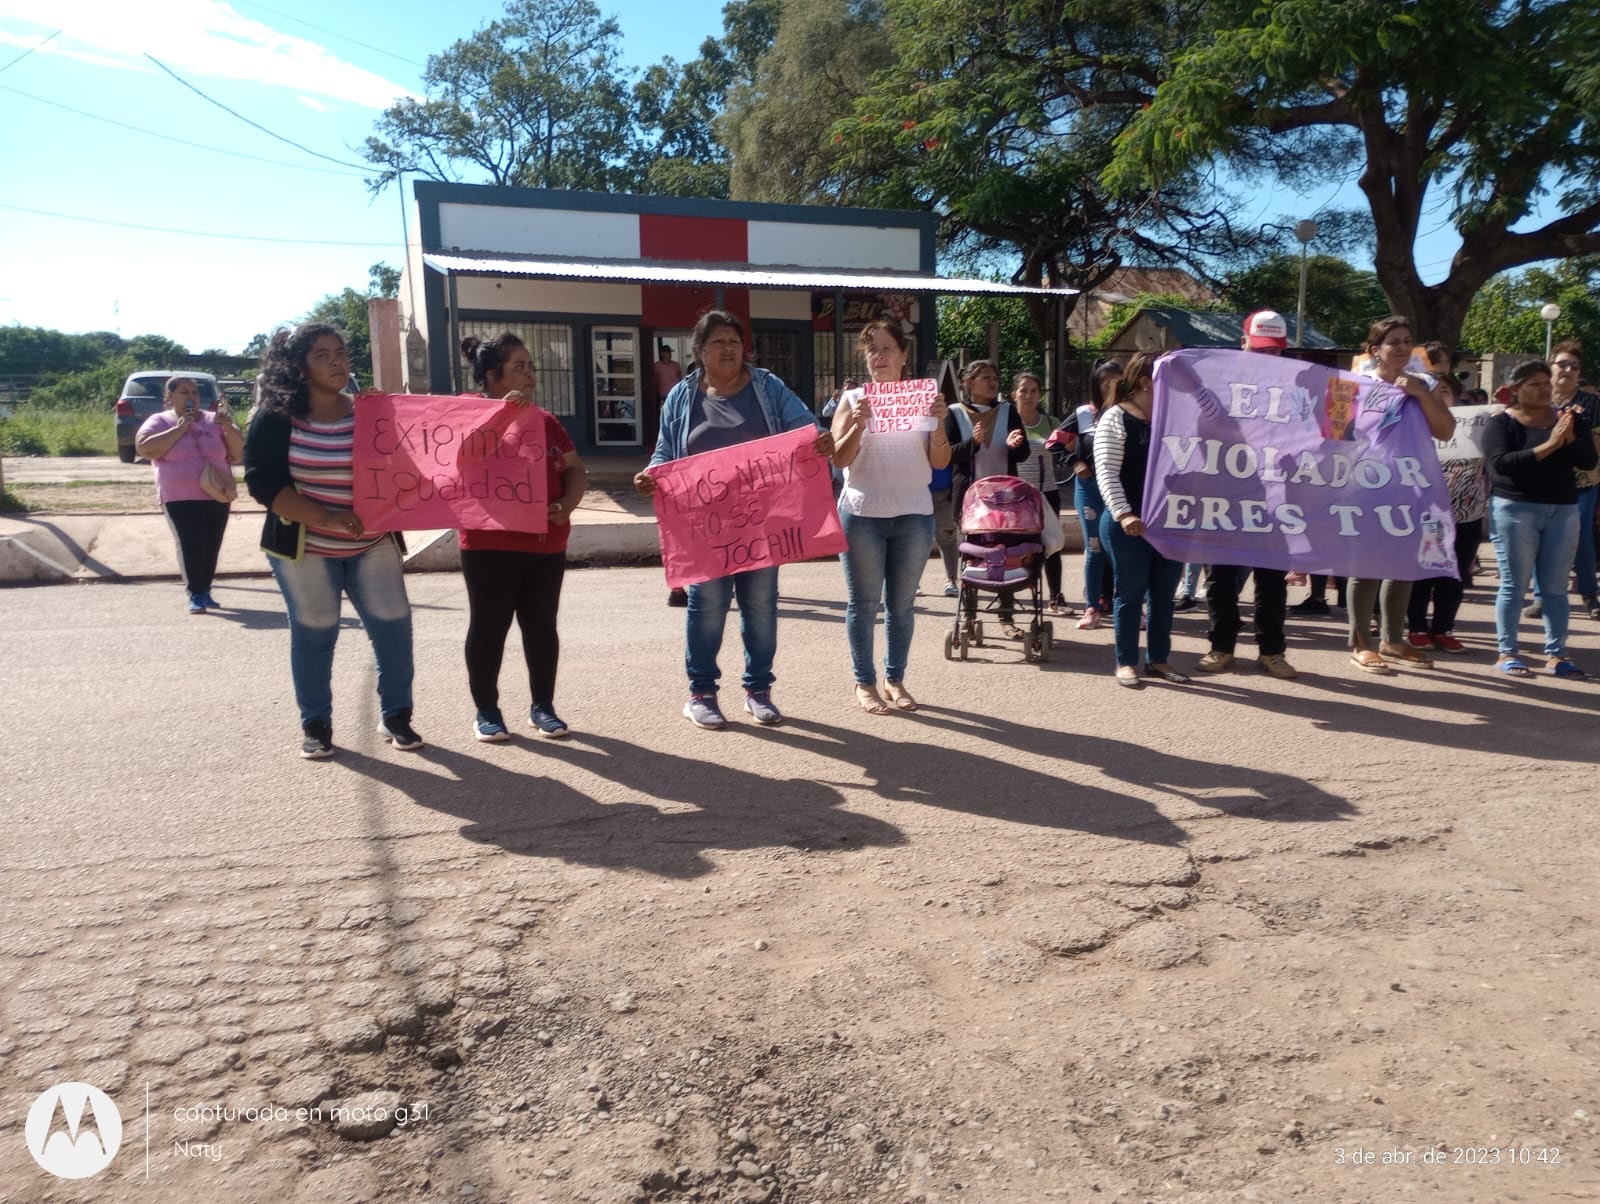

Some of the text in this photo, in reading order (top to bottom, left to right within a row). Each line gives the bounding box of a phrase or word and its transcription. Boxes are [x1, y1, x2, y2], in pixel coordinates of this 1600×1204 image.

[863, 379, 935, 395] NO QUEREMOS
[1227, 382, 1293, 425] EL
[373, 418, 545, 466] Exigimos
[1162, 435, 1433, 490] VIOLADOR
[680, 469, 729, 511] LOS
[691, 500, 765, 540] NO SE
[1163, 494, 1417, 538] ERES TU
[712, 526, 805, 569] TOCA!!!
